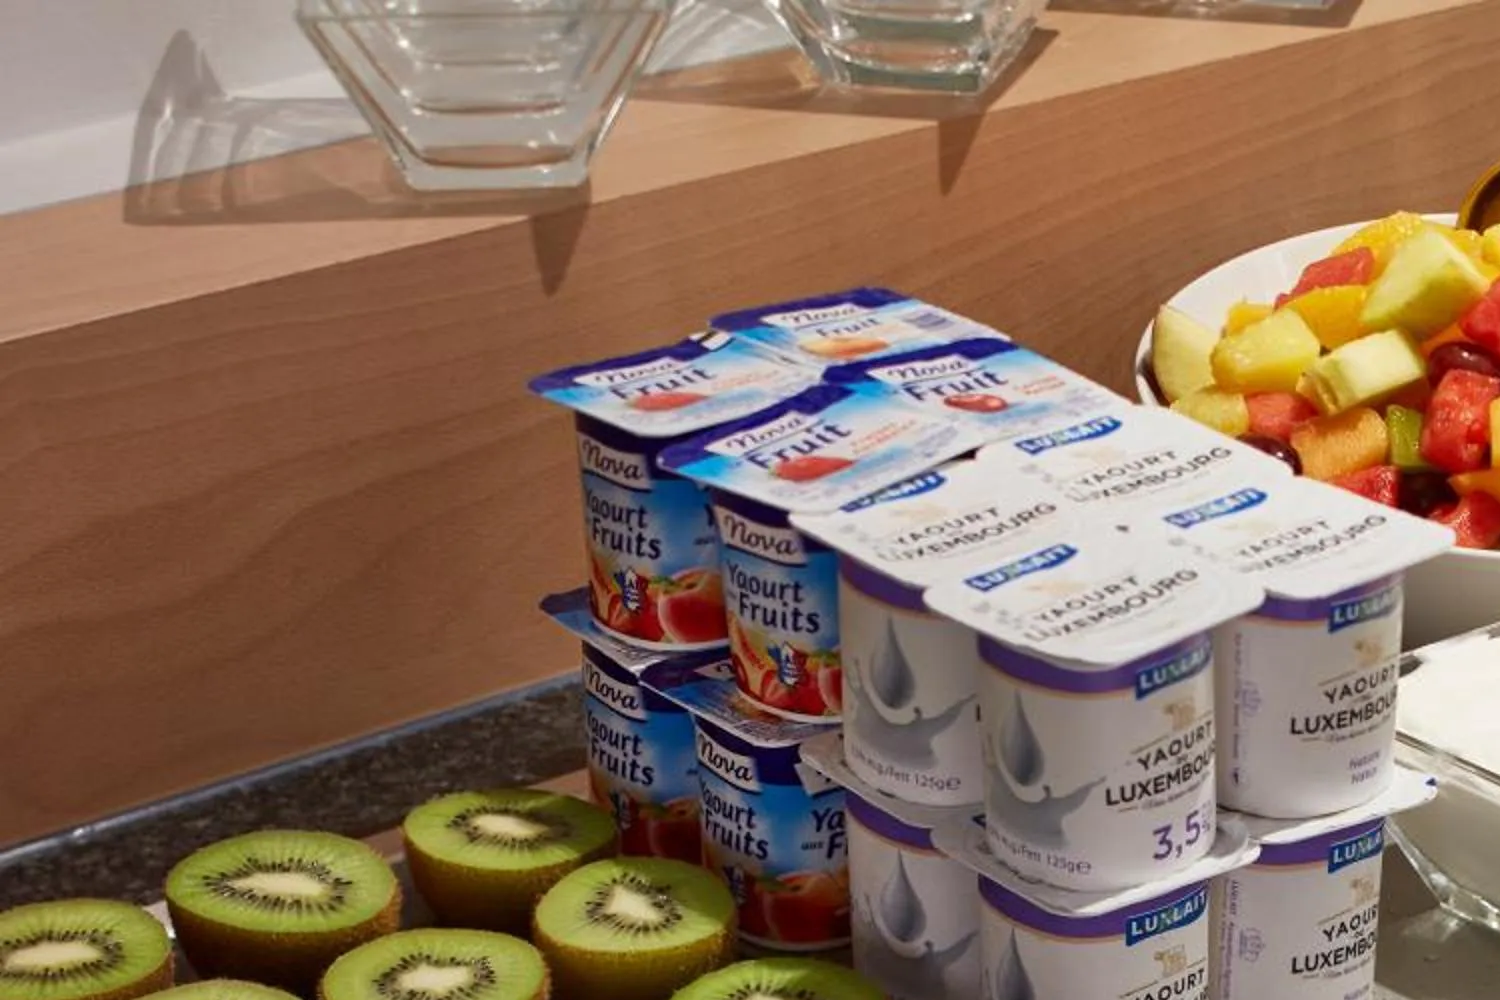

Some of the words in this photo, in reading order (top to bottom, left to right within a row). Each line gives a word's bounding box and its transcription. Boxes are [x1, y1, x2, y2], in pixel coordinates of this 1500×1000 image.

[780, 306, 858, 327] Nova
[815, 316, 881, 339] Fruit
[594, 361, 677, 384] Nova
[609, 366, 717, 400] Fruit
[887, 358, 969, 380] Nova
[902, 369, 1009, 402] Fruit
[726, 416, 805, 450] Nova
[747, 421, 853, 470] Fruit
[582, 437, 644, 481] Nova
[1078, 450, 1178, 487] YAOURT
[591, 517, 662, 560] Fruits
[723, 514, 798, 556] Nova
[895, 506, 1001, 545] YAOURT
[1239, 520, 1332, 558] YAOURT
[726, 560, 806, 605] Yaourt
[1032, 574, 1141, 624] YAOURT
[738, 591, 821, 634] Fruits
[1023, 567, 1200, 643] LUXEMBOURG
[586, 662, 640, 712] Nova
[1323, 663, 1396, 705] YAOURT
[591, 736, 656, 787] Fruits
[700, 739, 754, 782] Nova
[1136, 719, 1213, 772] YAOURT
[704, 808, 771, 861] Fruits
[1152, 809, 1201, 860] 3,5
[1131, 889, 1206, 937] LUXLAIT
